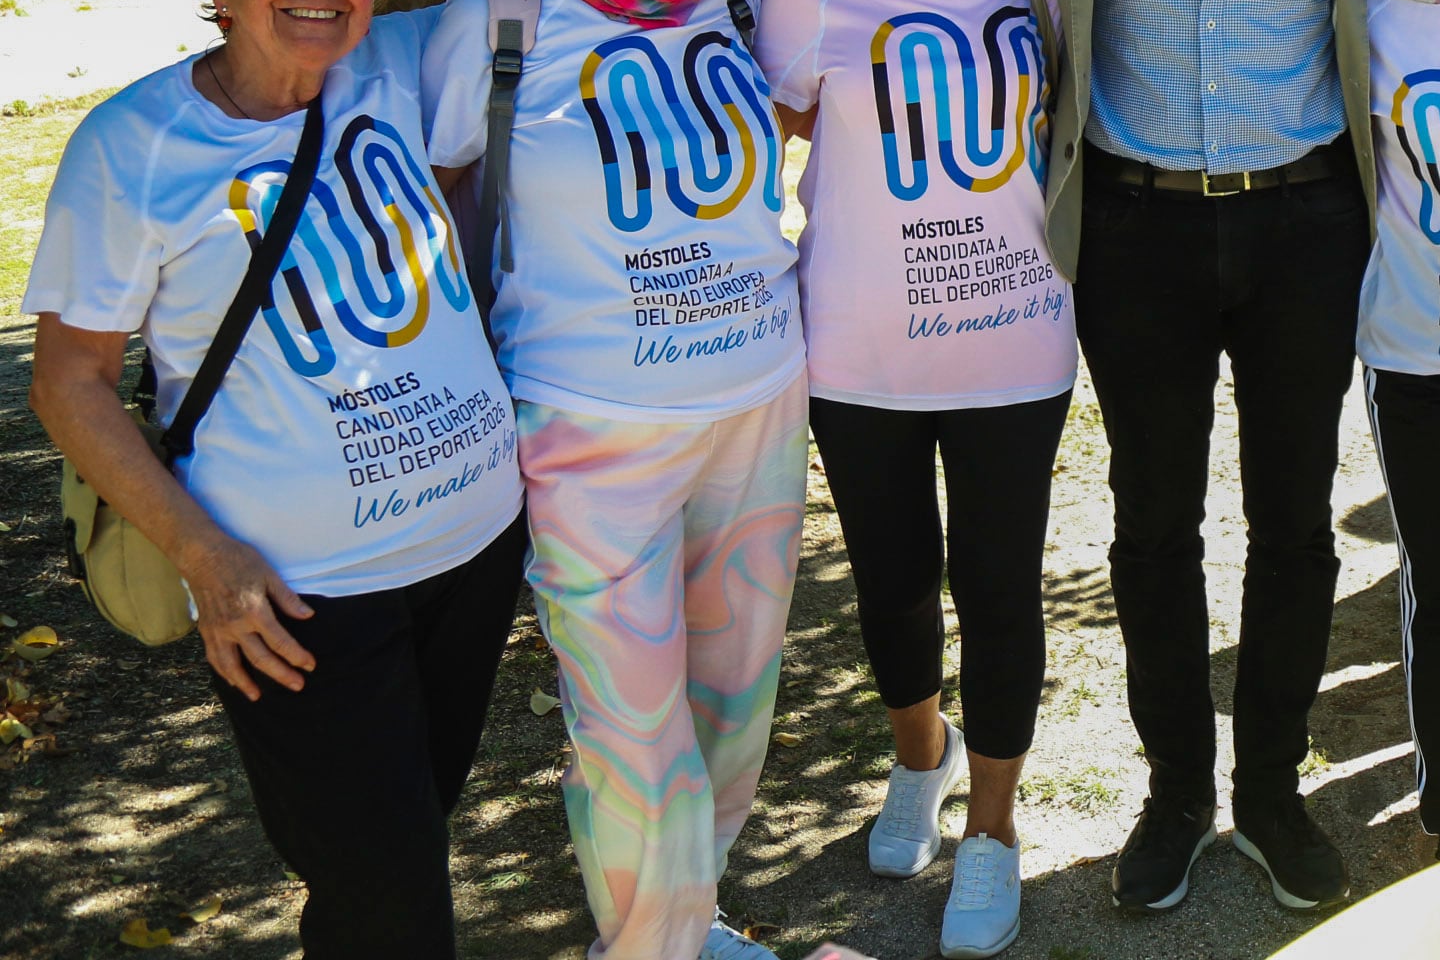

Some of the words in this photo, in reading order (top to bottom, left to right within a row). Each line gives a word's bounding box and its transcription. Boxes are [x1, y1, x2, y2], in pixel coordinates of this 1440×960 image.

[902, 216, 984, 240] MÓSTOLES
[625, 242, 711, 271] MÓSTOLES
[904, 238, 995, 263] CANDIDATA
[998, 236, 1008, 252] A
[906, 264, 970, 284] CIUDAD
[976, 248, 1039, 277] EUROPEA
[630, 264, 722, 293] CANDIDATA
[723, 262, 734, 276] A
[633, 290, 701, 307] CIUDAD
[703, 271, 765, 302] EUROPEA
[908, 288, 942, 305] DEL
[947, 274, 1017, 302] DEPORTE
[1020, 263, 1053, 288] 2026
[636, 308, 670, 326] DEL
[675, 296, 750, 324] DEPORTE
[752, 285, 773, 308] 2026
[908, 313, 952, 339] We
[956, 304, 1019, 334] make
[1024, 295, 1040, 319] it
[1043, 282, 1068, 321] big!
[634, 336, 682, 367] We
[687, 326, 748, 359] make
[753, 316, 767, 339] it
[771, 297, 792, 338] big!
[327, 371, 421, 413] MÓSTOLES
[335, 392, 444, 439] CANDIDATA
[441, 386, 457, 404] A
[342, 426, 425, 463] CIUDAD
[426, 389, 492, 439] EUROPEA
[349, 463, 394, 488] DEL
[400, 423, 481, 475] DEPORTE
[479, 401, 506, 437] 2026
[353, 489, 410, 528] We
[416, 462, 484, 507] make
[488, 441, 501, 471] it
